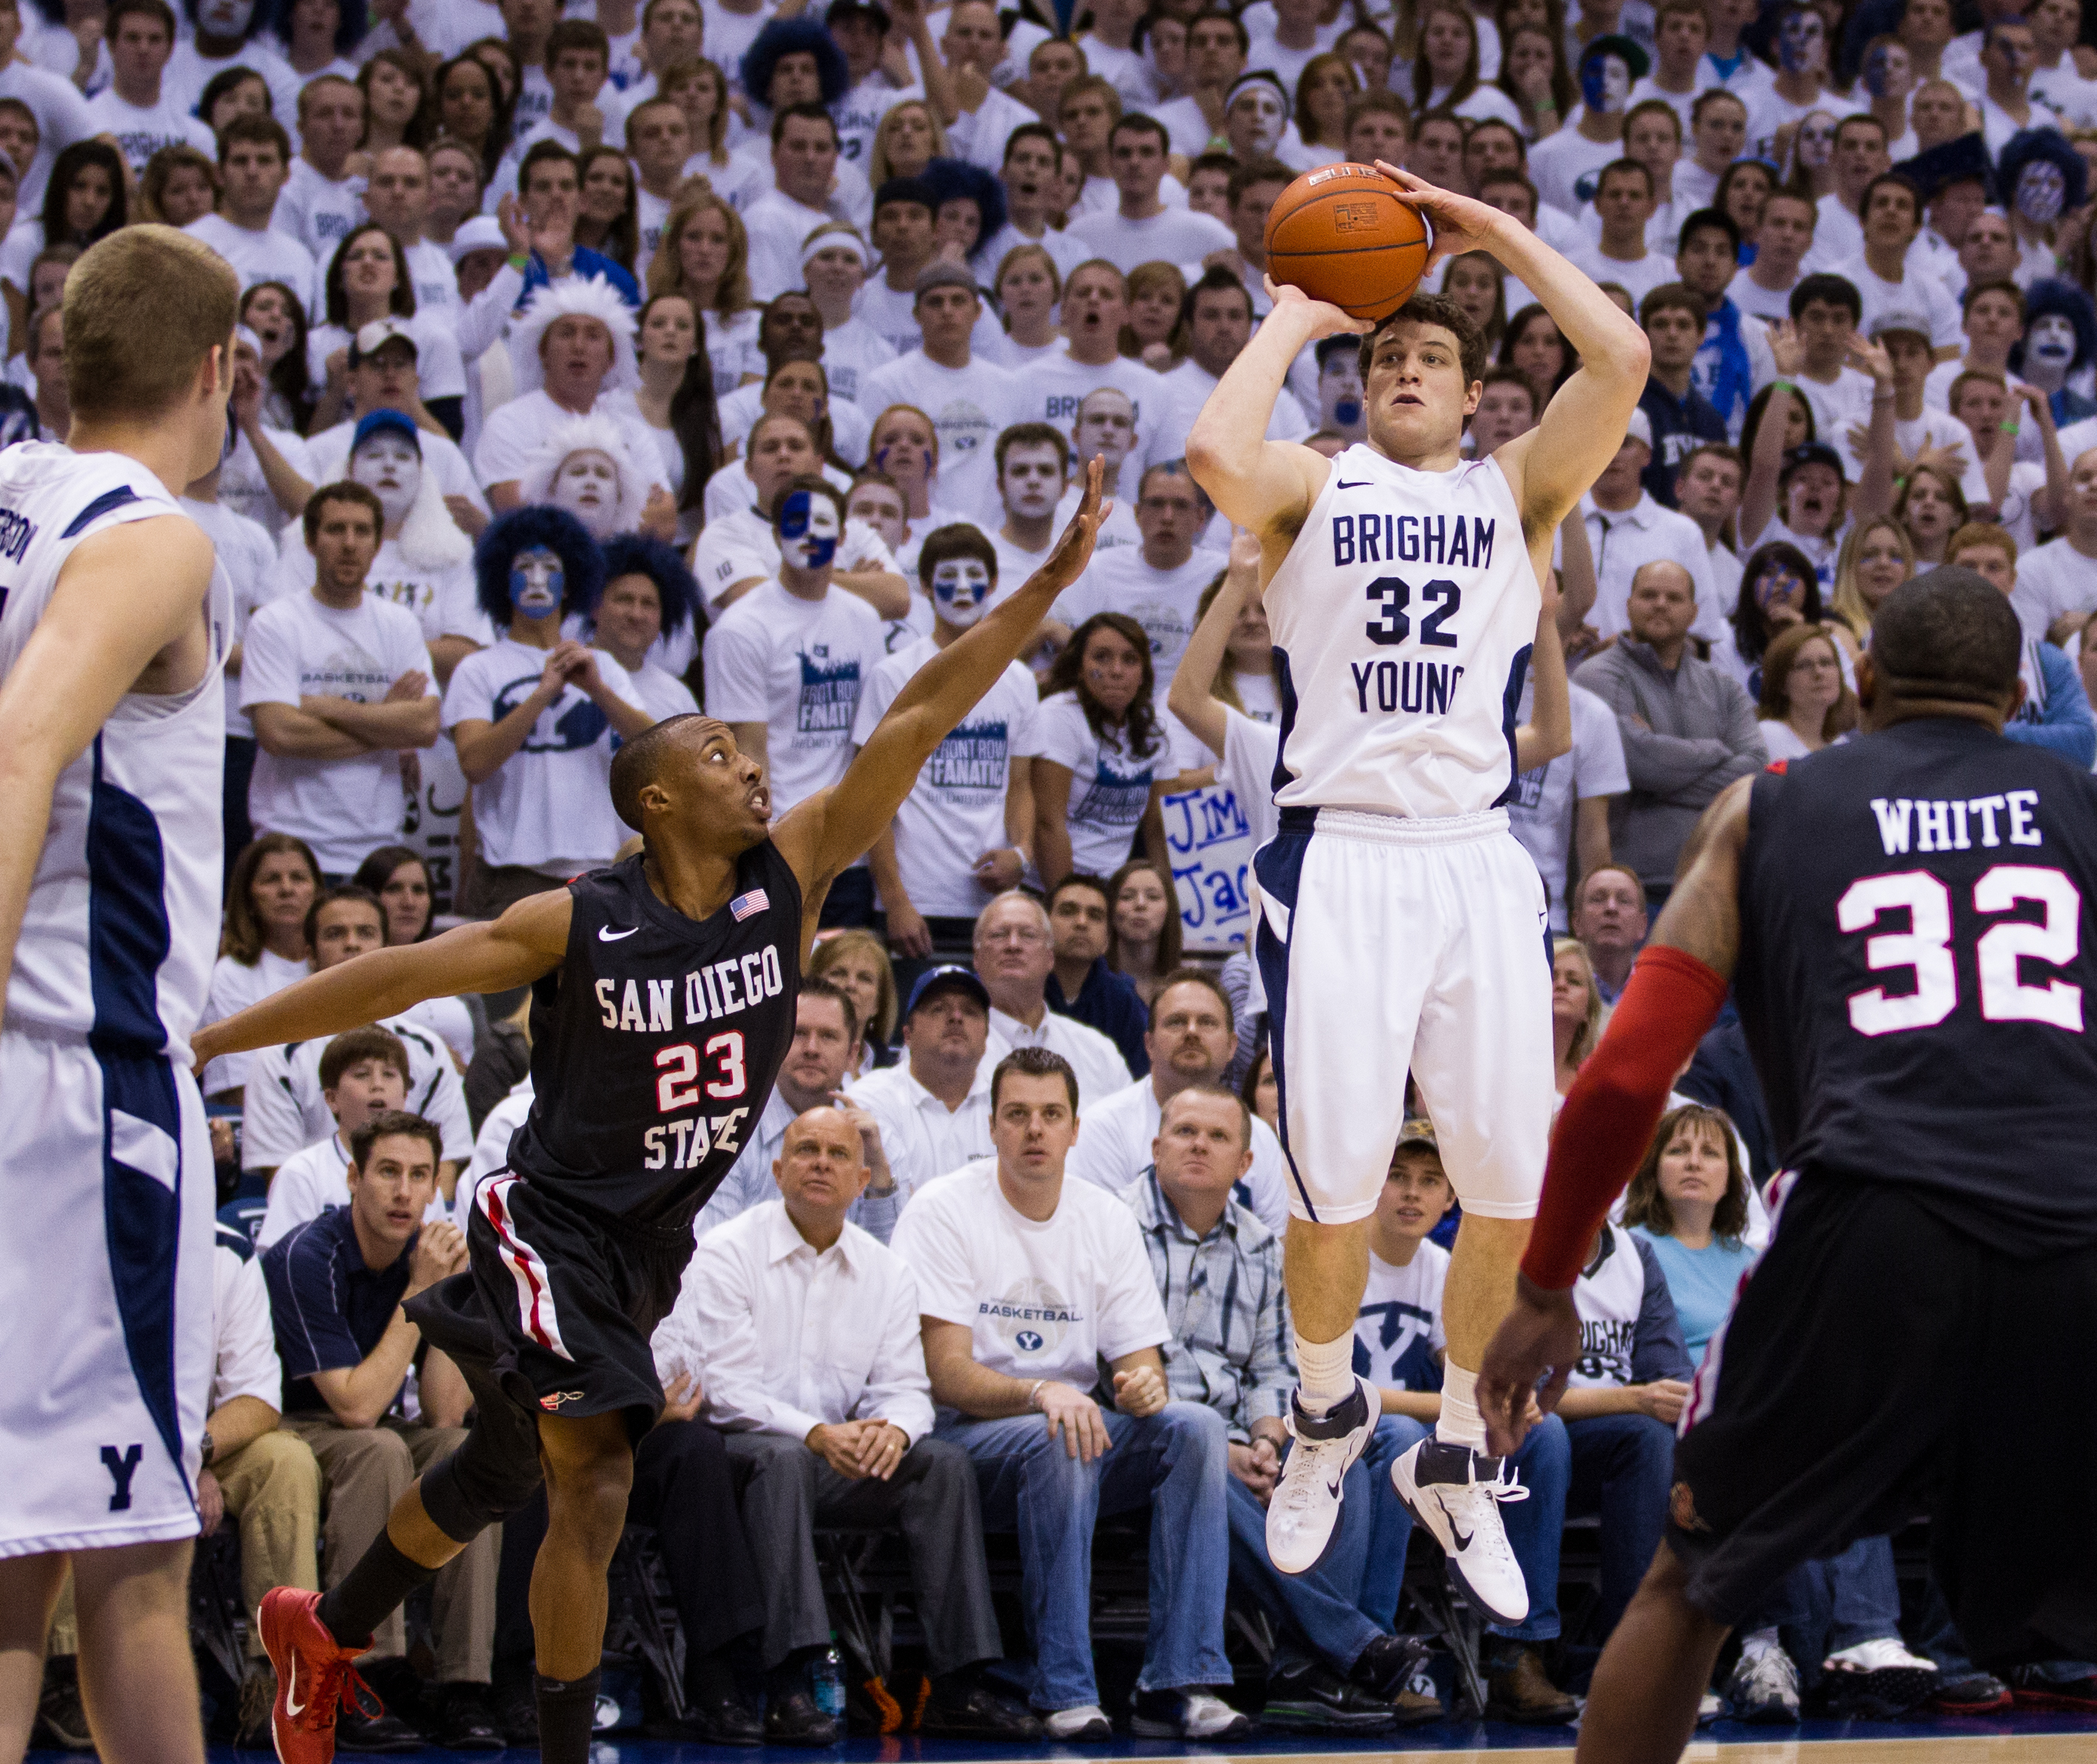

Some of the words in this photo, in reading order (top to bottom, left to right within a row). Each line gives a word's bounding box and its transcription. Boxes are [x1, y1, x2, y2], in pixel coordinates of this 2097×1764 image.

[1332, 514, 1495, 569] BRIGHAM
[1366, 577, 1461, 648] 32
[301, 672, 391, 684] BASKETBAL
[934, 759, 1004, 786] FANATIC
[978, 739, 1006, 760] ROW
[1869, 789, 2042, 856] WHITE
[1835, 864, 2084, 1037] 32
[594, 978, 674, 1032] SAN
[685, 944, 783, 1025] DIEGO
[654, 1028, 748, 1113] 23
[100, 1443, 143, 1512] Y
